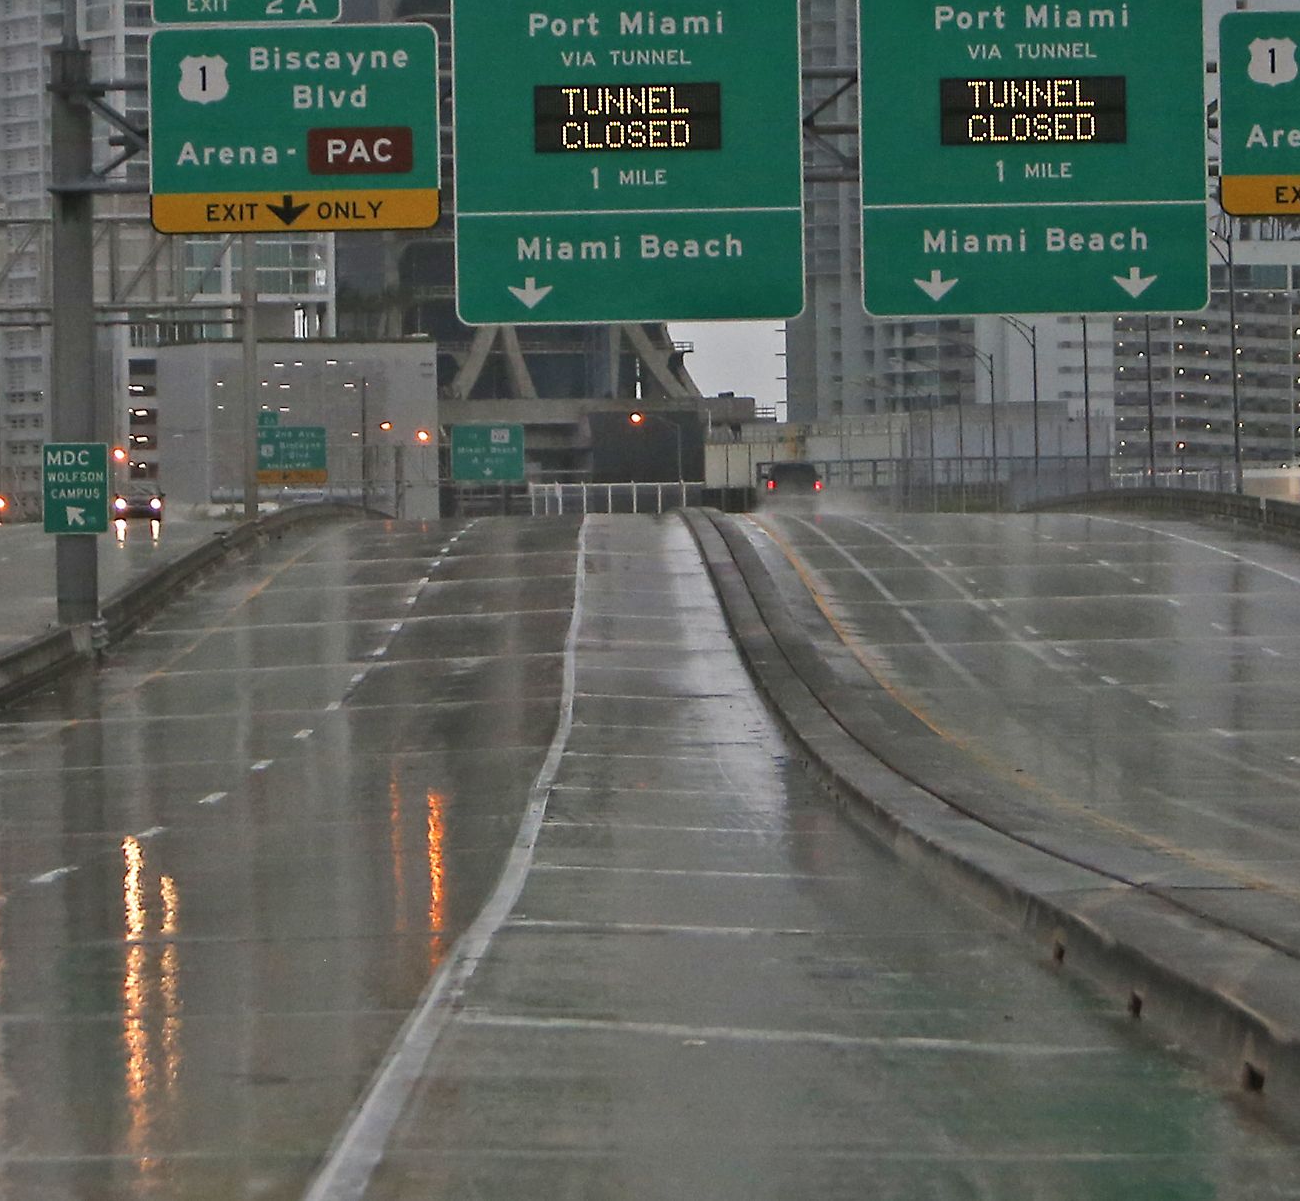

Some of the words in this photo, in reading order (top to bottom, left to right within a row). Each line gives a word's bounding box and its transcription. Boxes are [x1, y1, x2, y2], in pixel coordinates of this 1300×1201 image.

[528, 12, 600, 37] Port
[619, 10, 723, 35] Miami
[934, 5, 1005, 30] Port
[1025, 2, 1128, 29] Miami
[249, 46, 409, 76] Biscayne
[560, 51, 596, 67] VIA
[609, 49, 692, 66] TUNNEL
[967, 44, 1002, 60] VIA
[1015, 42, 1097, 59] TUNNEL
[1268, 47, 1276, 74] 1
[199, 65, 207, 92] 1
[293, 84, 367, 109] Blvd
[561, 86, 690, 116] TUNNEL
[967, 79, 1095, 108] TUNNEL
[562, 119, 690, 149] CLOSED
[968, 113, 1096, 142] CLOSED
[327, 137, 392, 163] PAC
[590, 166, 599, 190] 1
[619, 169, 667, 185] MILE
[995, 159, 1004, 183] 1
[1024, 162, 1072, 178] MILE
[206, 203, 259, 222] EXIT
[317, 200, 383, 220] ONLY
[517, 235, 621, 261] Miami
[640, 233, 743, 259] Beach
[923, 228, 1026, 254] Miami
[1046, 227, 1148, 252] Beach
[47, 450, 89, 466] MDC
[47, 471, 103, 483] WOLFSON
[51, 488, 100, 499] CAMPUS
